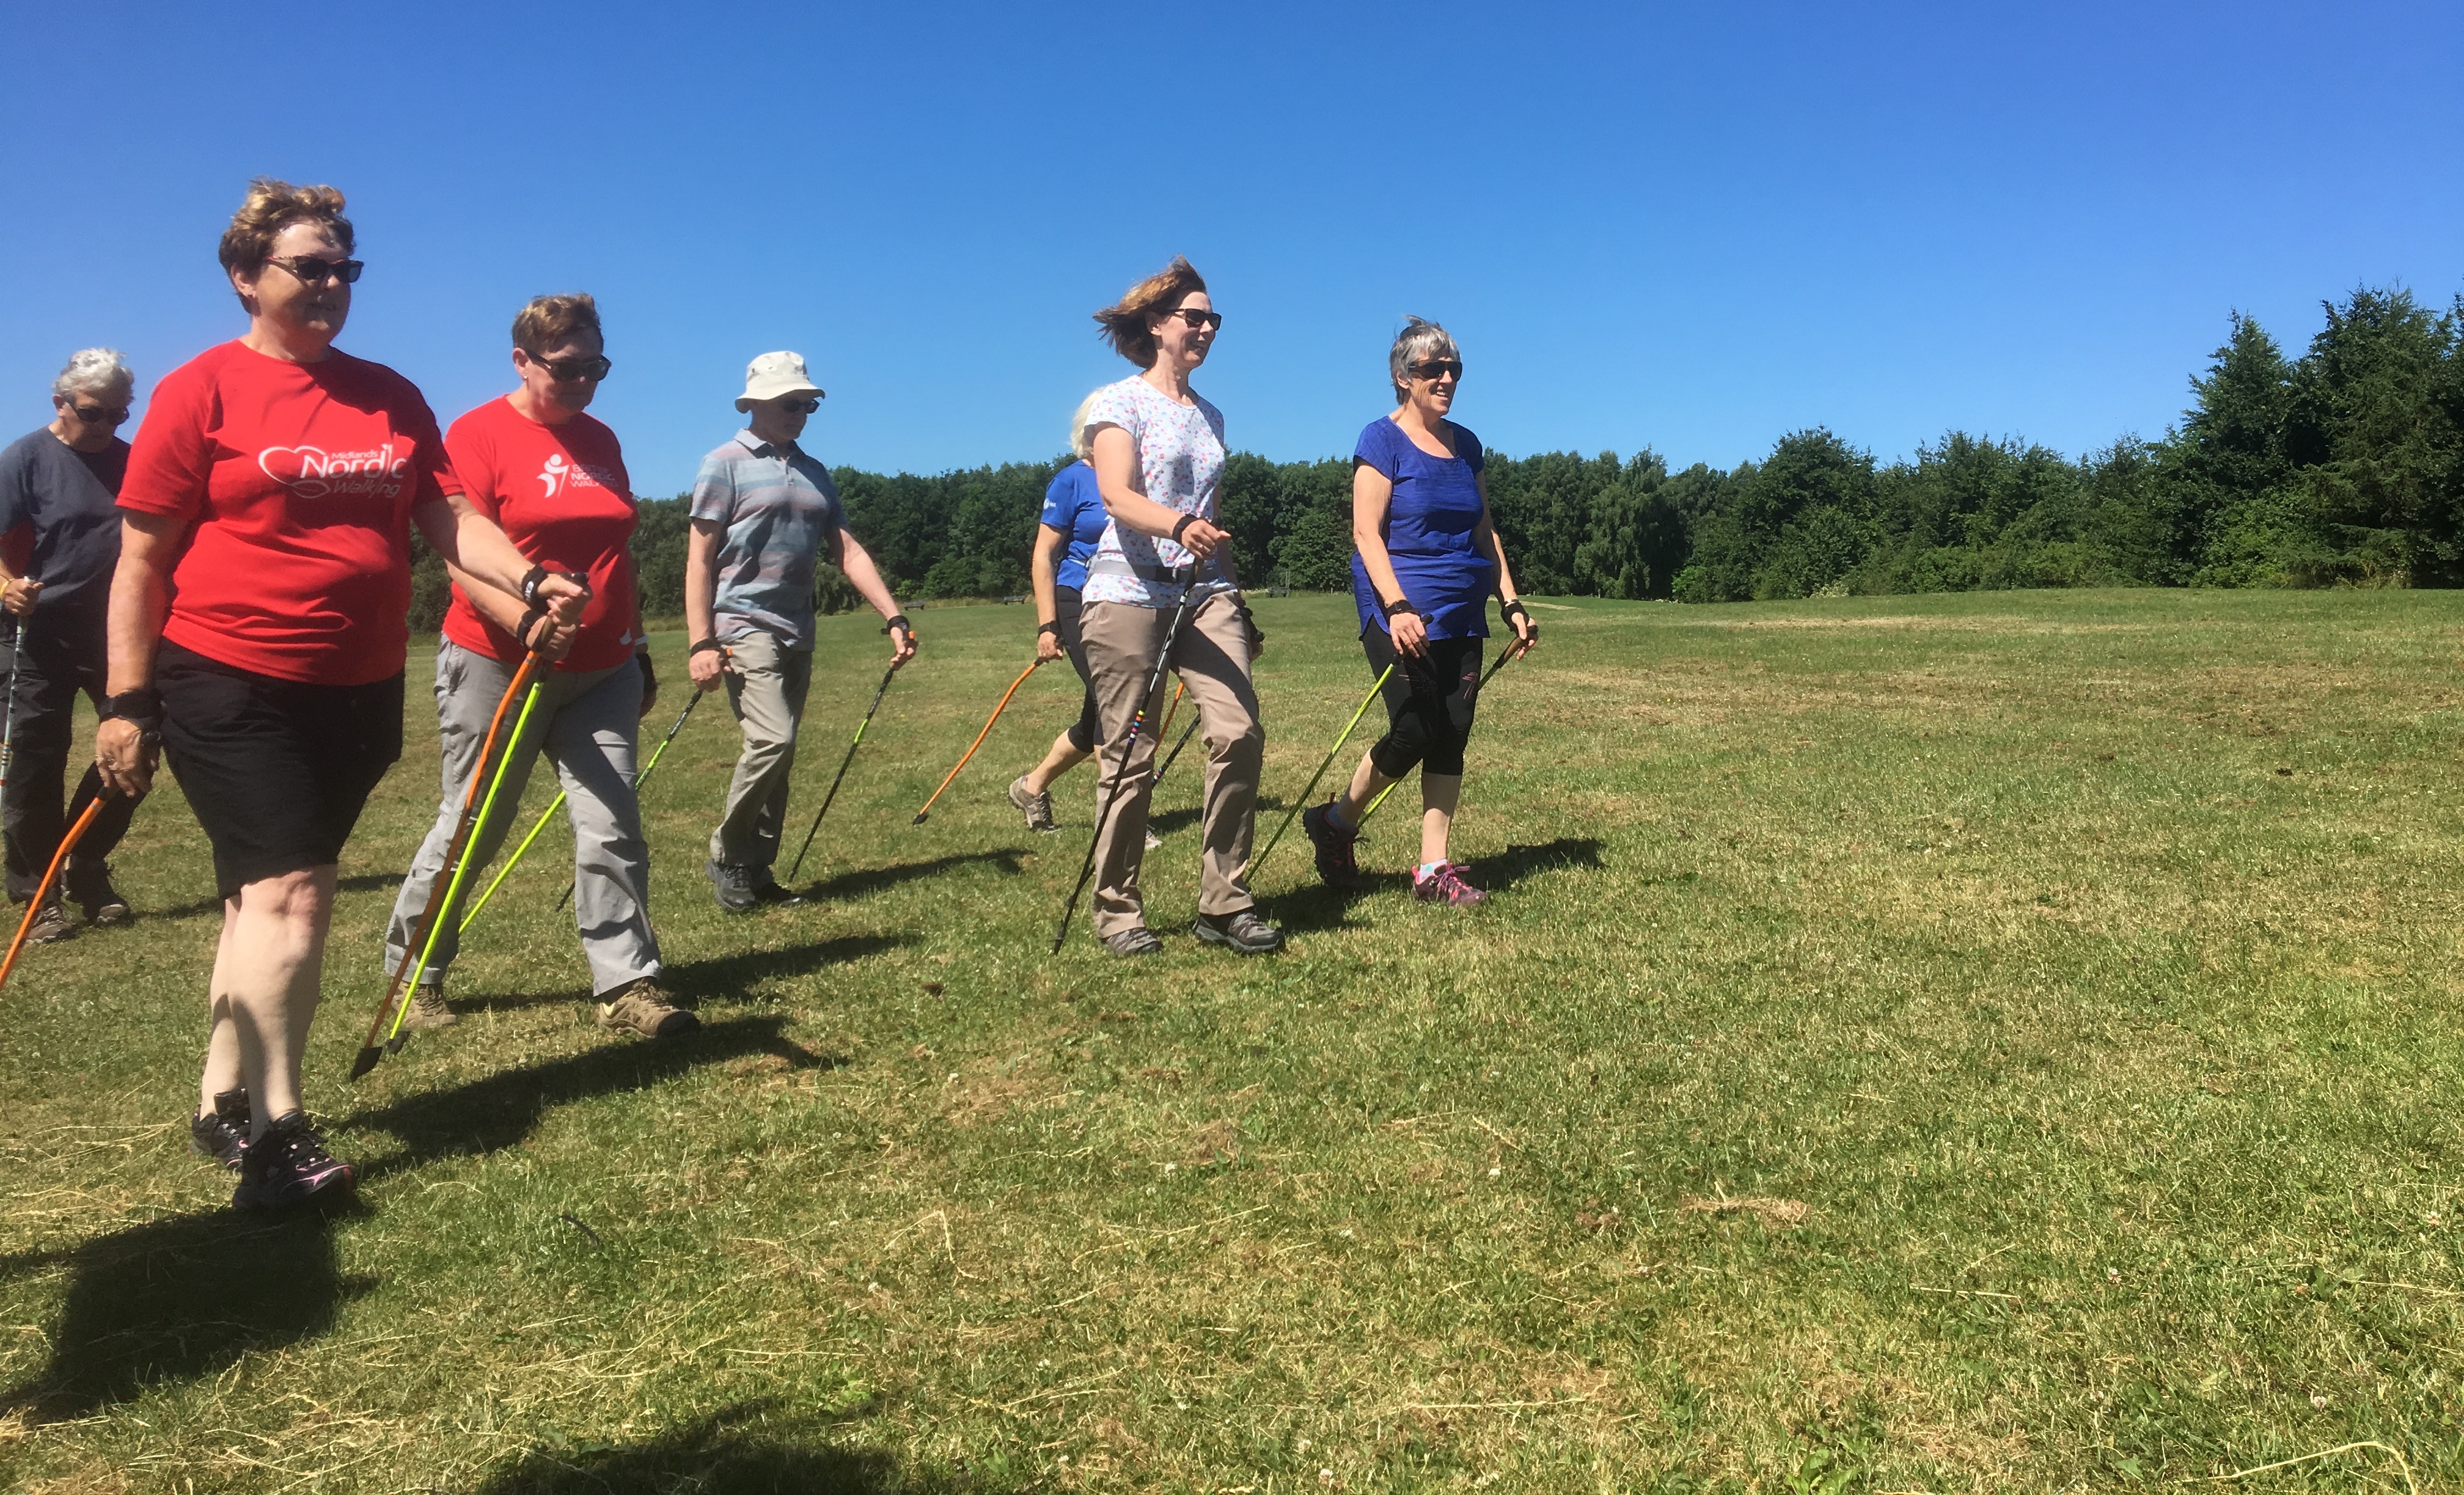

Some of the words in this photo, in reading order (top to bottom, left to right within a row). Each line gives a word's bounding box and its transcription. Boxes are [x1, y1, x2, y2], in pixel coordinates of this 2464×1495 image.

[299, 444, 407, 478] Nordic
[331, 450, 378, 459] Midlands
[333, 480, 401, 498] Walking
